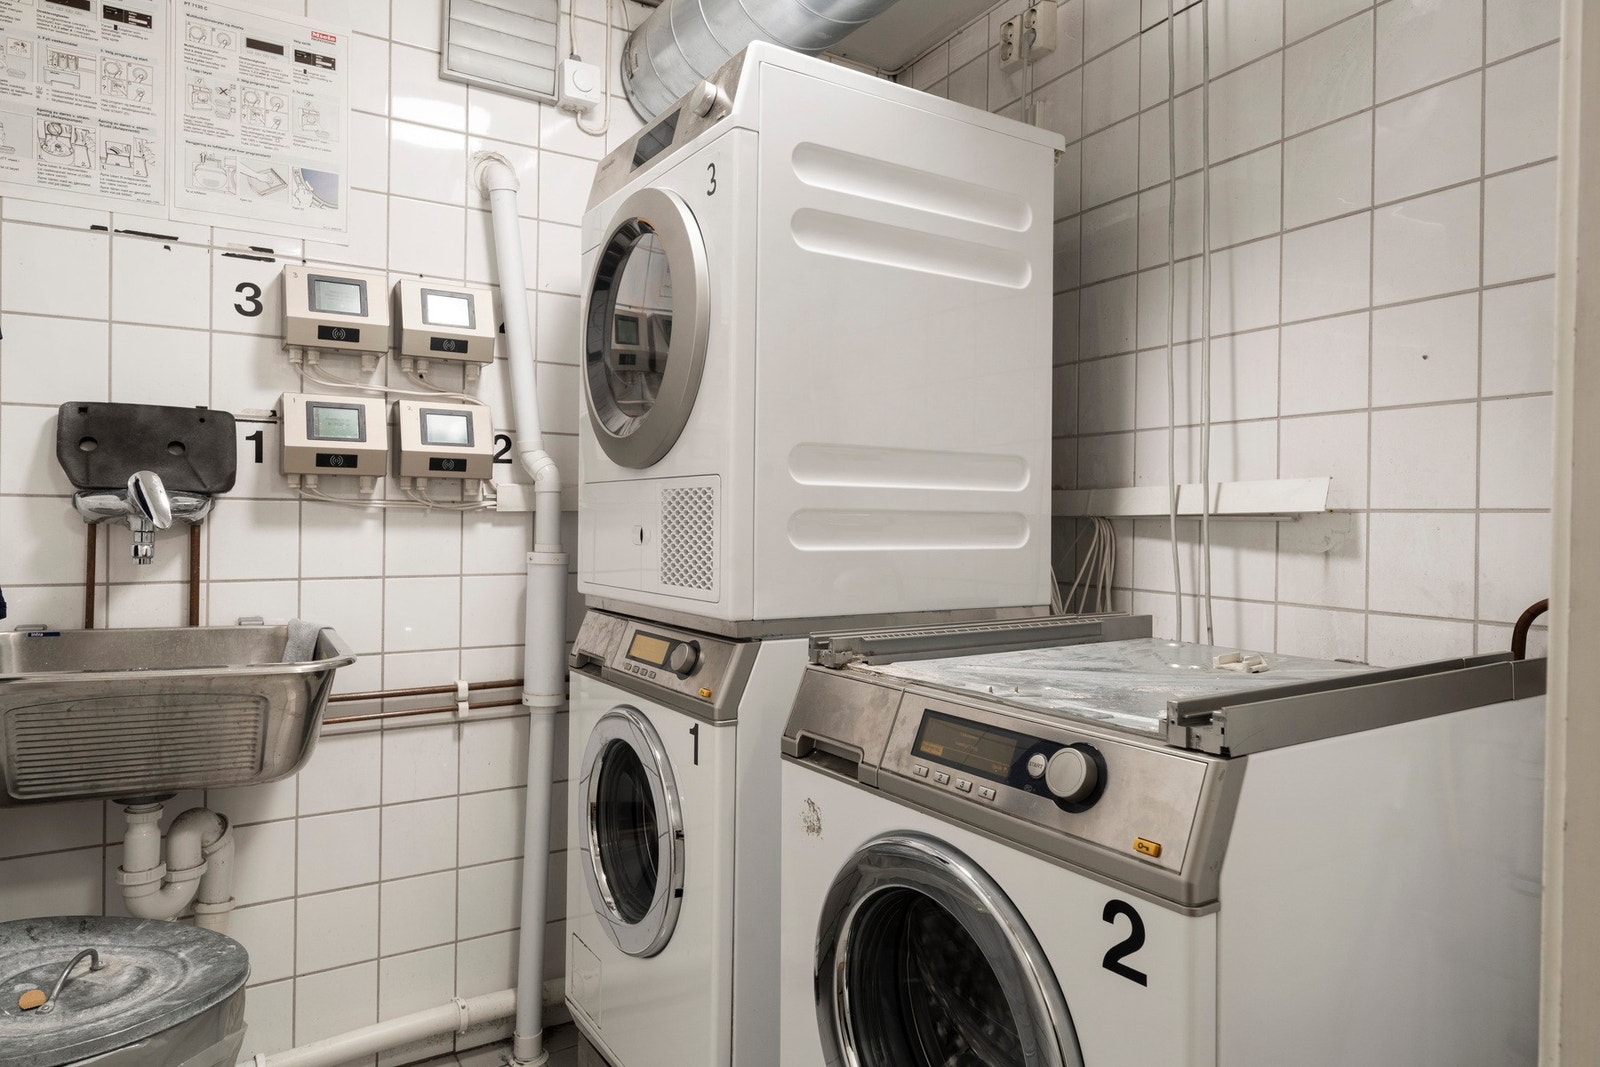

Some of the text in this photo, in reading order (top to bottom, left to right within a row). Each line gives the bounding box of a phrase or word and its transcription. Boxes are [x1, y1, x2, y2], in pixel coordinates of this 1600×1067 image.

[312, 32, 336, 42] Miele
[707, 163, 716, 196] 3
[234, 282, 263, 317] 3
[246, 430, 263, 463] 1
[493, 434, 512, 464] 2
[689, 723, 698, 766] 1
[1029, 761, 1043, 769] START
[1102, 899, 1147, 987] 2
